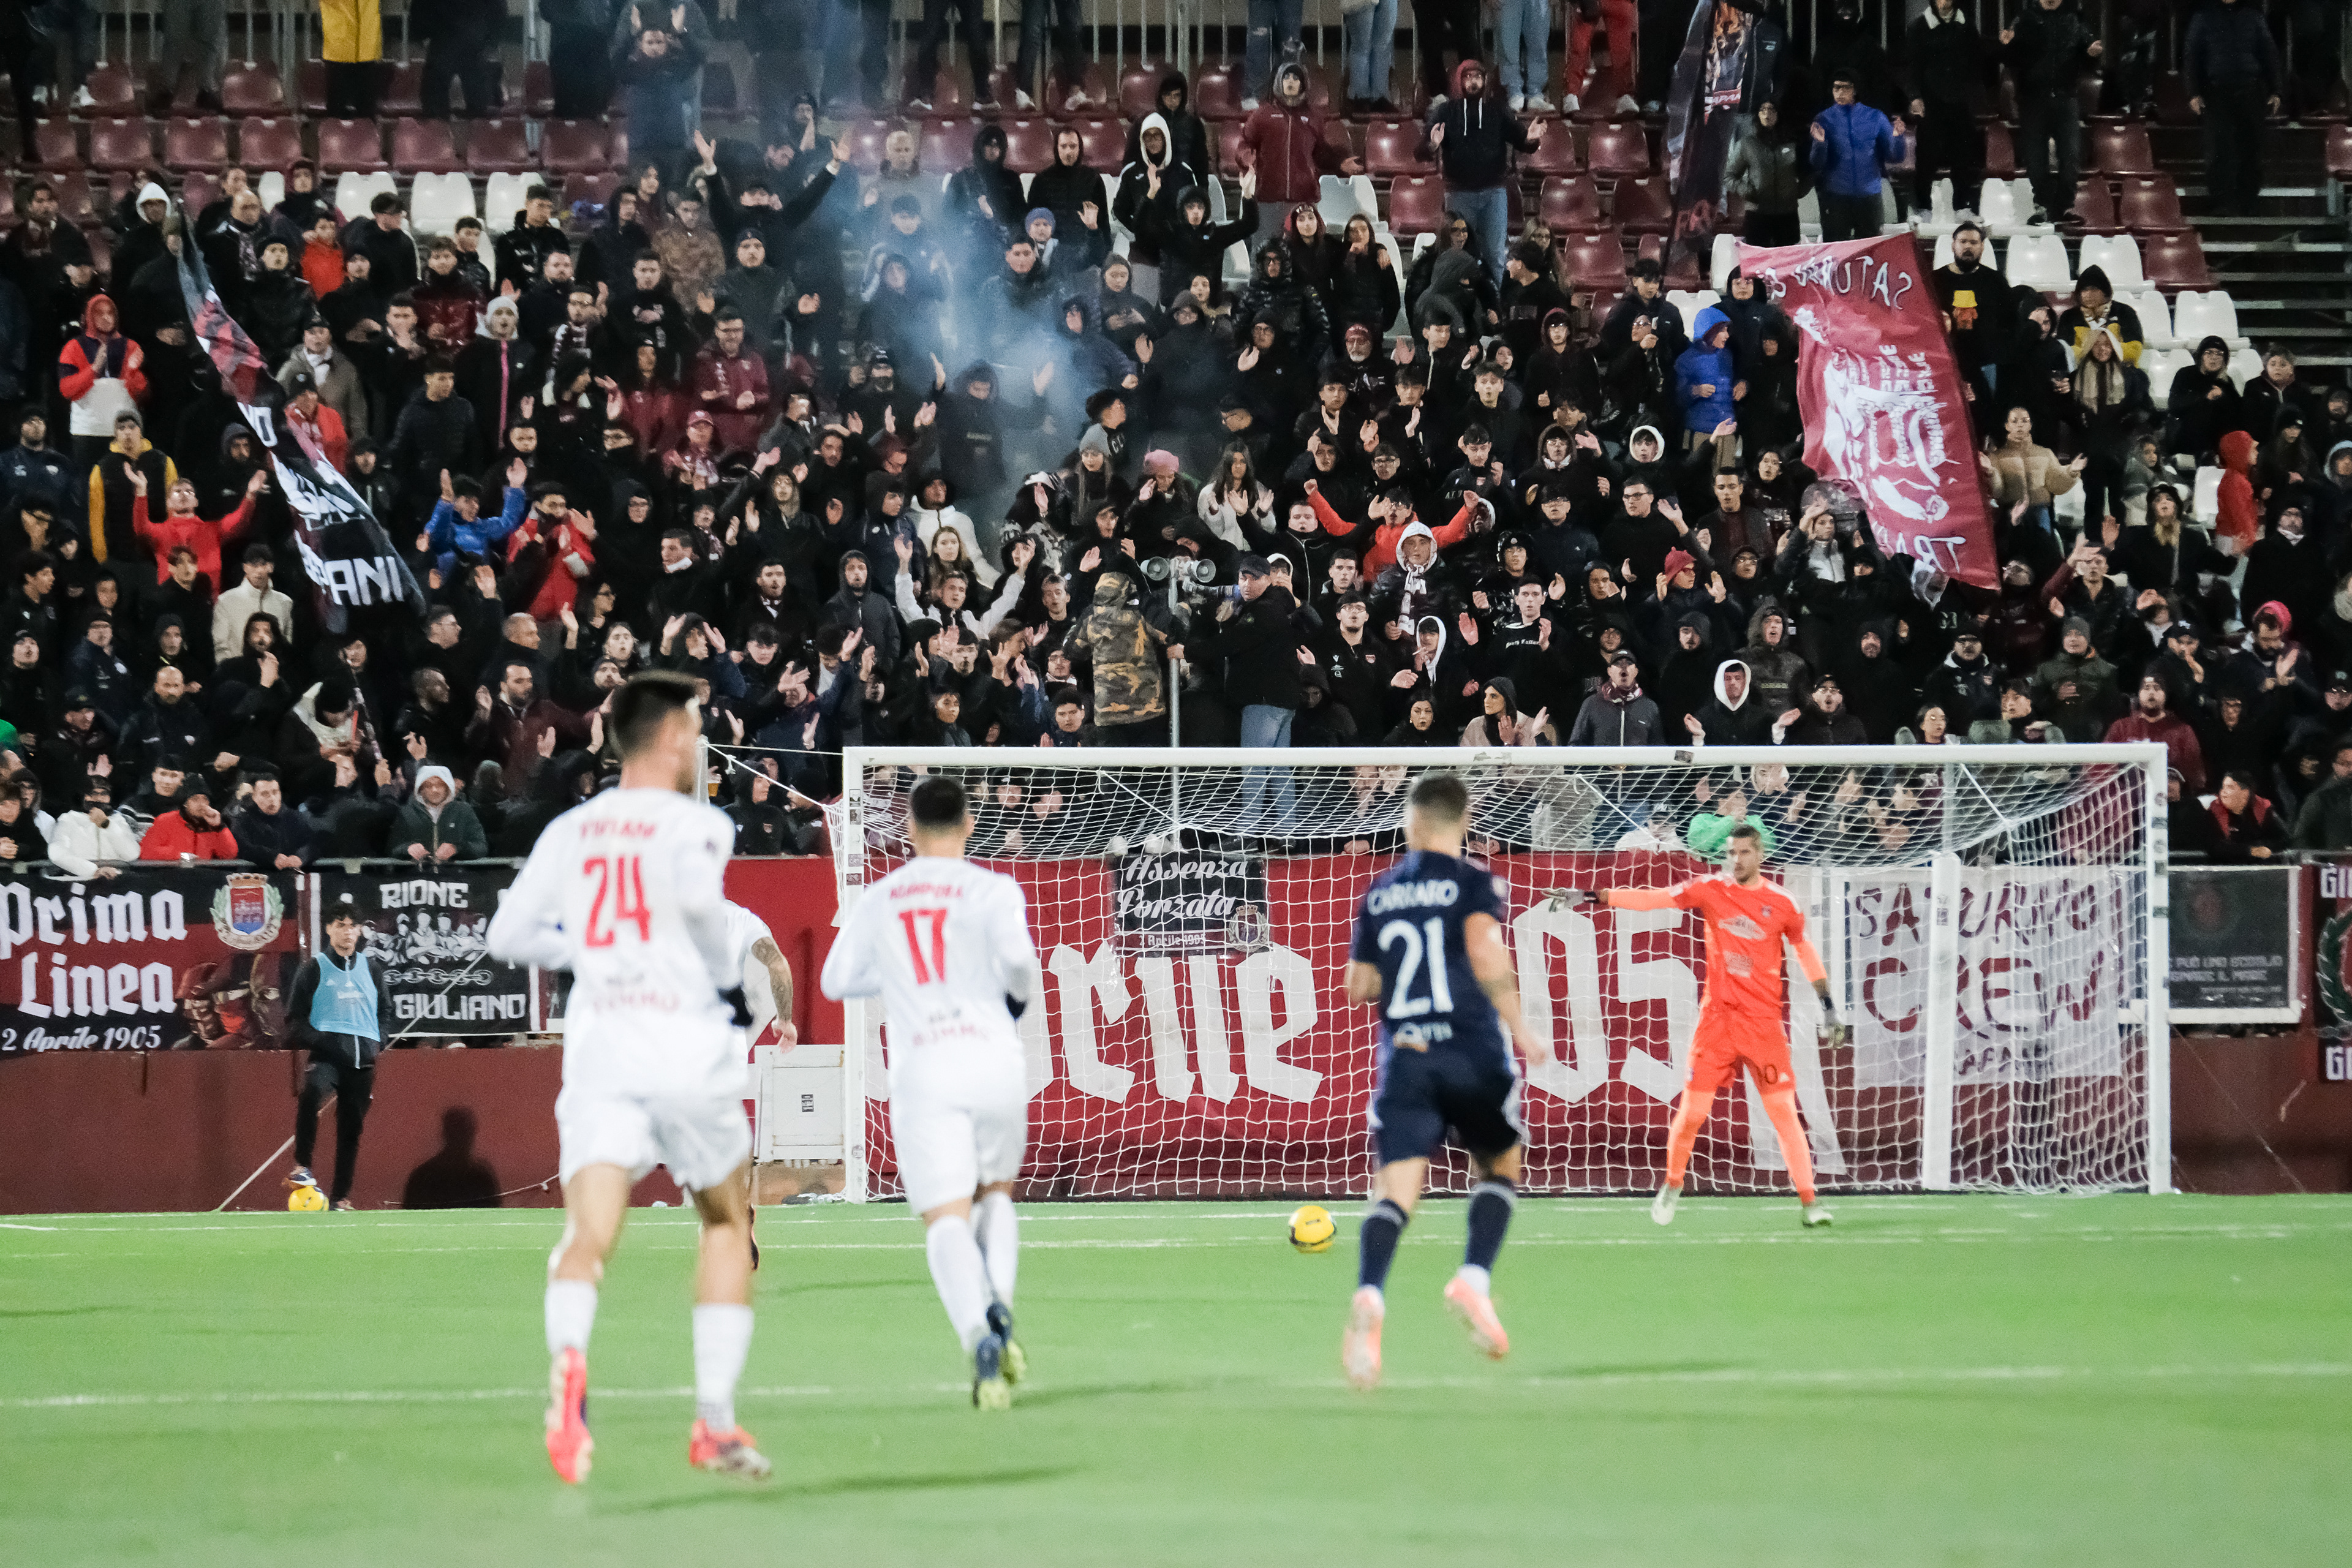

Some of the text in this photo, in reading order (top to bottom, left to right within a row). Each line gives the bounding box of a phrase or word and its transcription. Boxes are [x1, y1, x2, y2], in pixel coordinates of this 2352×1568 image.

[379, 880, 469, 909] RIONE
[582, 854, 652, 948] 24
[1125, 855, 1248, 883] Assenza
[0, 881, 188, 960] Prima
[898, 908, 947, 985] 17
[18, 951, 178, 1019] Linea
[1378, 917, 1454, 1019] 21
[1, 1025, 162, 1053] 2 Aprile 1905
[393, 993, 527, 1020] GIULIANO
